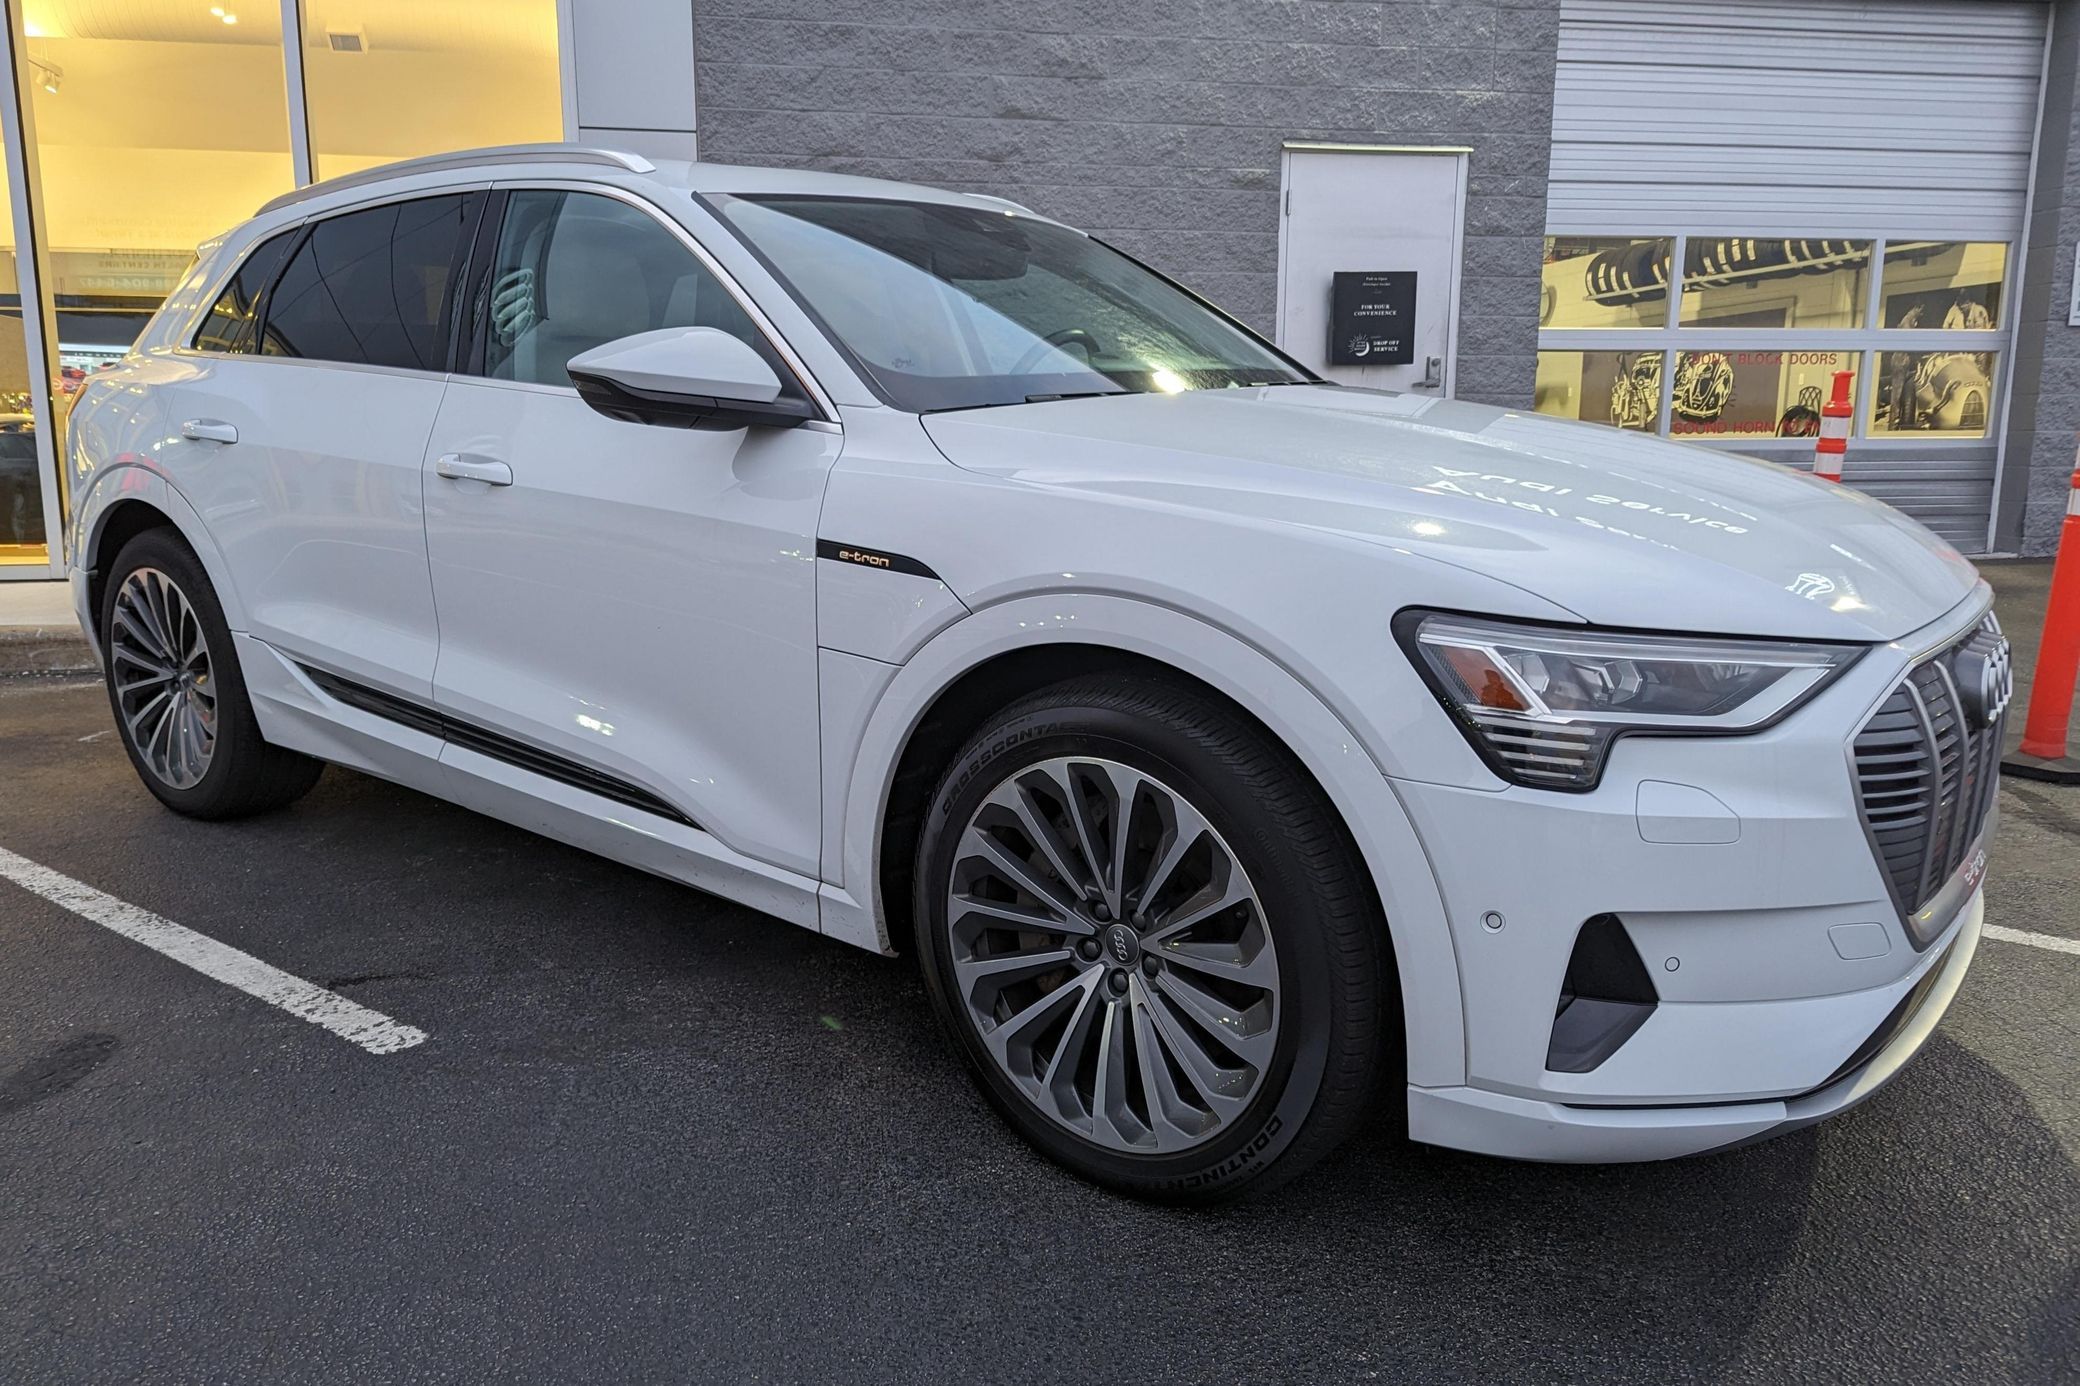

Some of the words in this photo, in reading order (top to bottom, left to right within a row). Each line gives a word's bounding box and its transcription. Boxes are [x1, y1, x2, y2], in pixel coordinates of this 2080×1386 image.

[1738, 352, 1783, 365] BLOCK
[1790, 352, 1837, 365] DOORS
[1673, 421, 1727, 434] SOUND
[1733, 420, 1776, 433] HORN
[839, 550, 890, 568] e-tron
